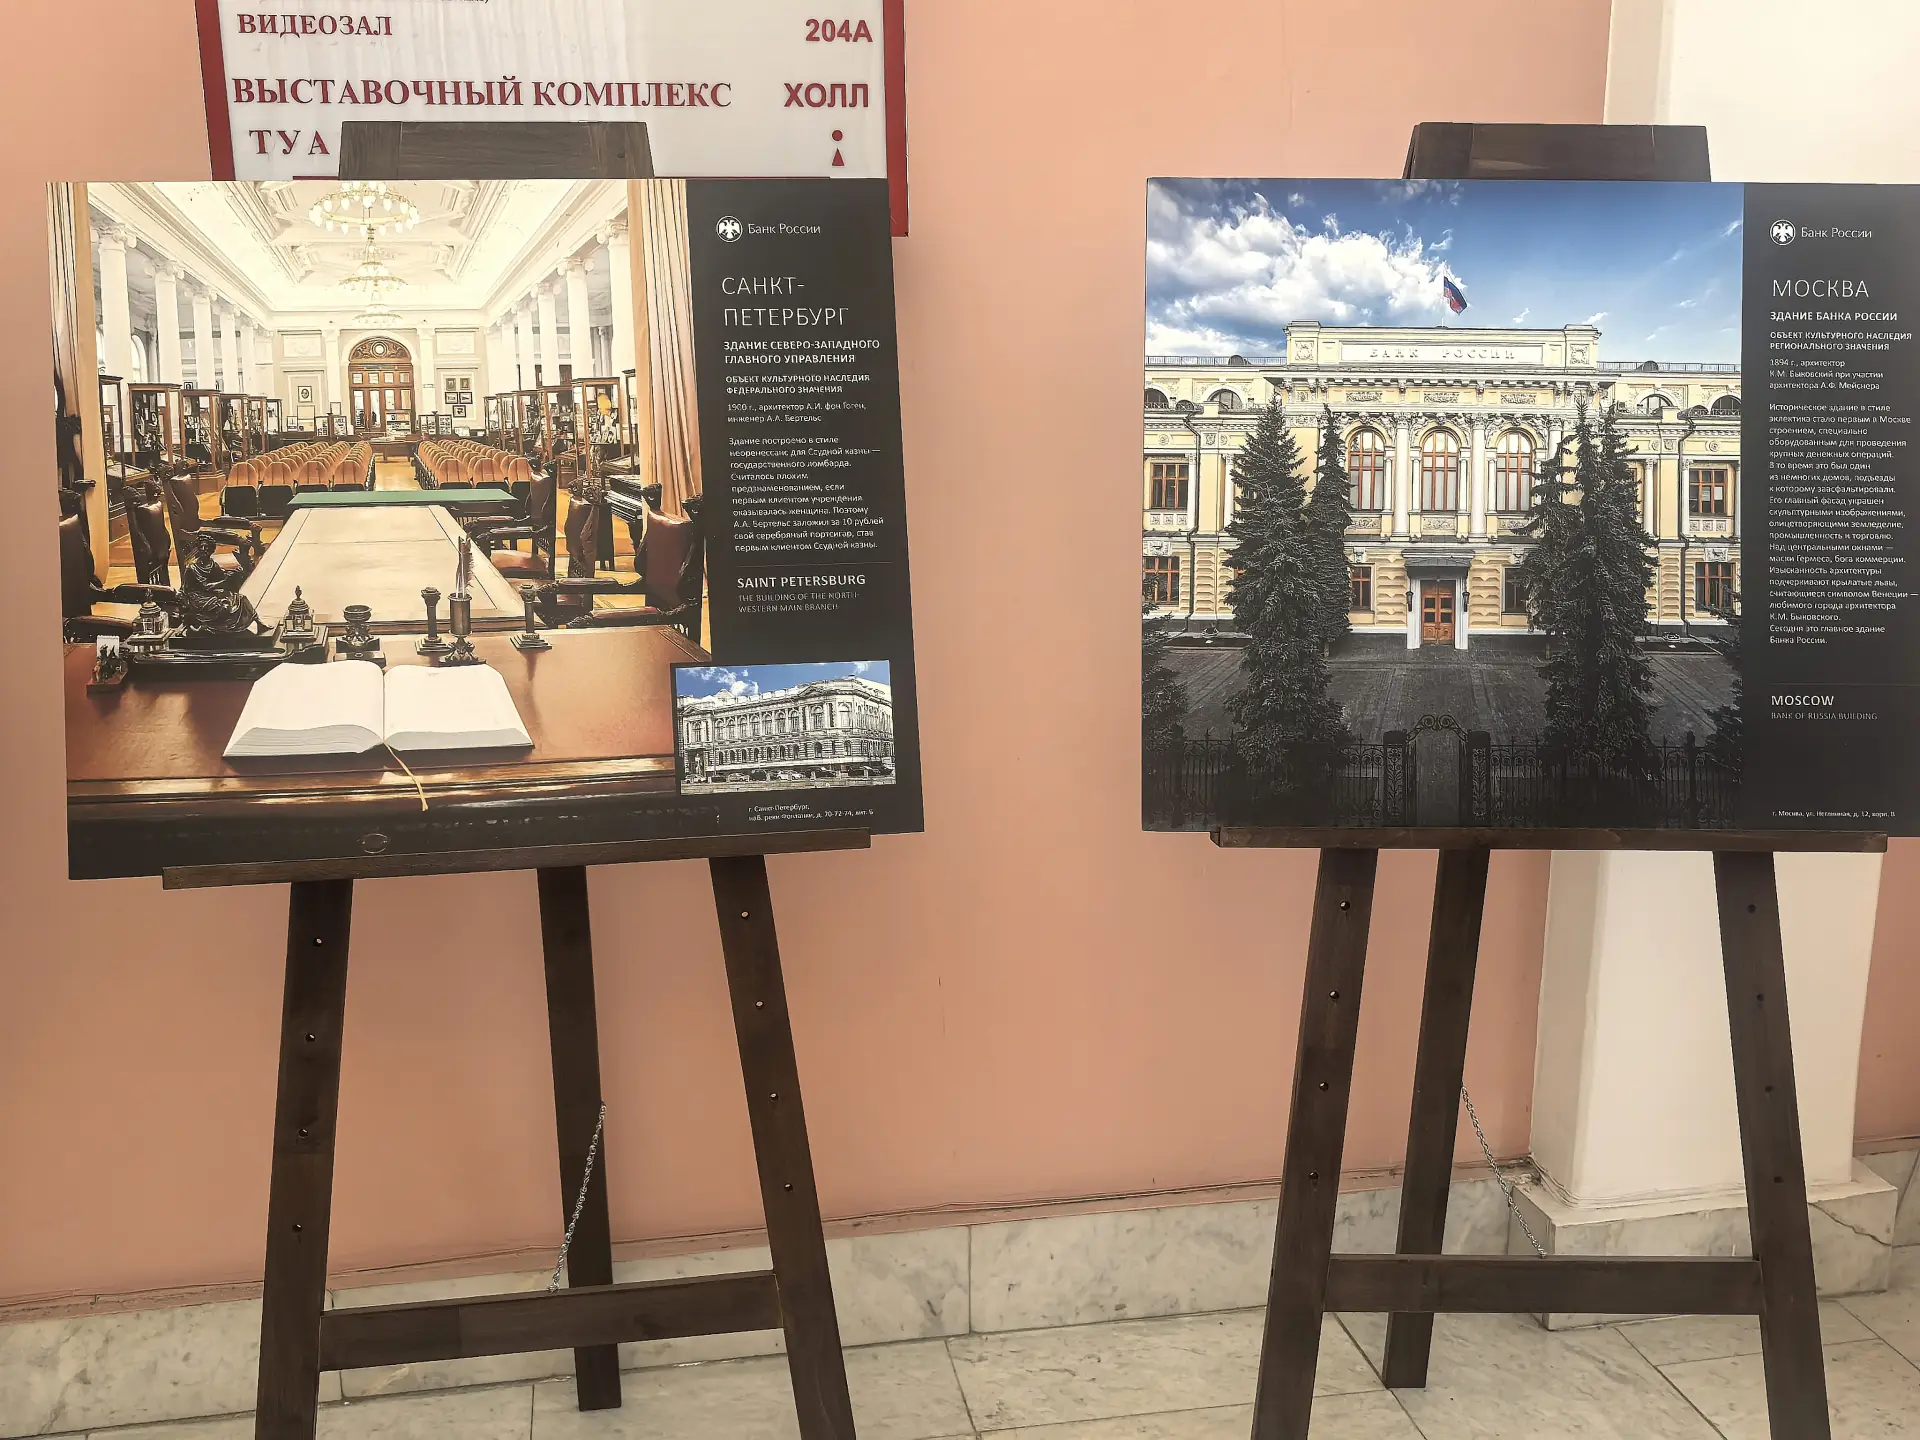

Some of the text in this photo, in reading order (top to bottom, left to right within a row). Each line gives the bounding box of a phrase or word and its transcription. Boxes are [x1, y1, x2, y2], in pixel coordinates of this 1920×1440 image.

[237, 13, 393, 40] ВИДЕОЗАЛ
[805, 19, 873, 44] 204А
[232, 73, 733, 109] ВЫСТАВОЧНЫЙ КОМПЛЕКС
[784, 82, 870, 109] ХОЛЛ
[248, 129, 330, 157] ТУА
[748, 223, 821, 234] Банк России
[1801, 226, 1872, 239] Банк России
[721, 276, 805, 295] САНКТ-
[1772, 279, 1870, 298] МОСКВА
[724, 307, 849, 327] ПЕТЕРБУРГ
[1770, 311, 1898, 322] ЗДАНИЕ БАНКА РОССИИ
[1770, 331, 1912, 341] ОБЪЕКТ КУЛЬТУРНОГО НАСЛЕДИЯ
[723, 339, 880, 352] ЗДАНИЕ СЕВЕРО-ЗАПАДНОГО
[1770, 342, 1890, 351] РЕГИОНАЛЬНОГО ЗНАЧЕНИЯ
[724, 354, 856, 364] ГЛАВНОГО УПРАВЛЕНИЯ
[725, 374, 870, 383] ОБЪЕКТ КУЛЬТУРНОГО НАСЛЕДИЯ
[726, 385, 843, 395] ФЕДЕРАЛЬНОГО ЗНАЧЕНИЯ
[758, 403, 805, 413] архитектор
[728, 437, 760, 447] Здание
[815, 436, 839, 444] стиле
[842, 517, 852, 526] 10
[854, 517, 884, 527] рублей
[734, 531, 754, 540] свой
[737, 574, 866, 588] SAINT PETERSBURG
[779, 604, 802, 612] MAIN
[1771, 695, 1835, 706] MOSCOW
[1807, 712, 1837, 720] RUSSIA
